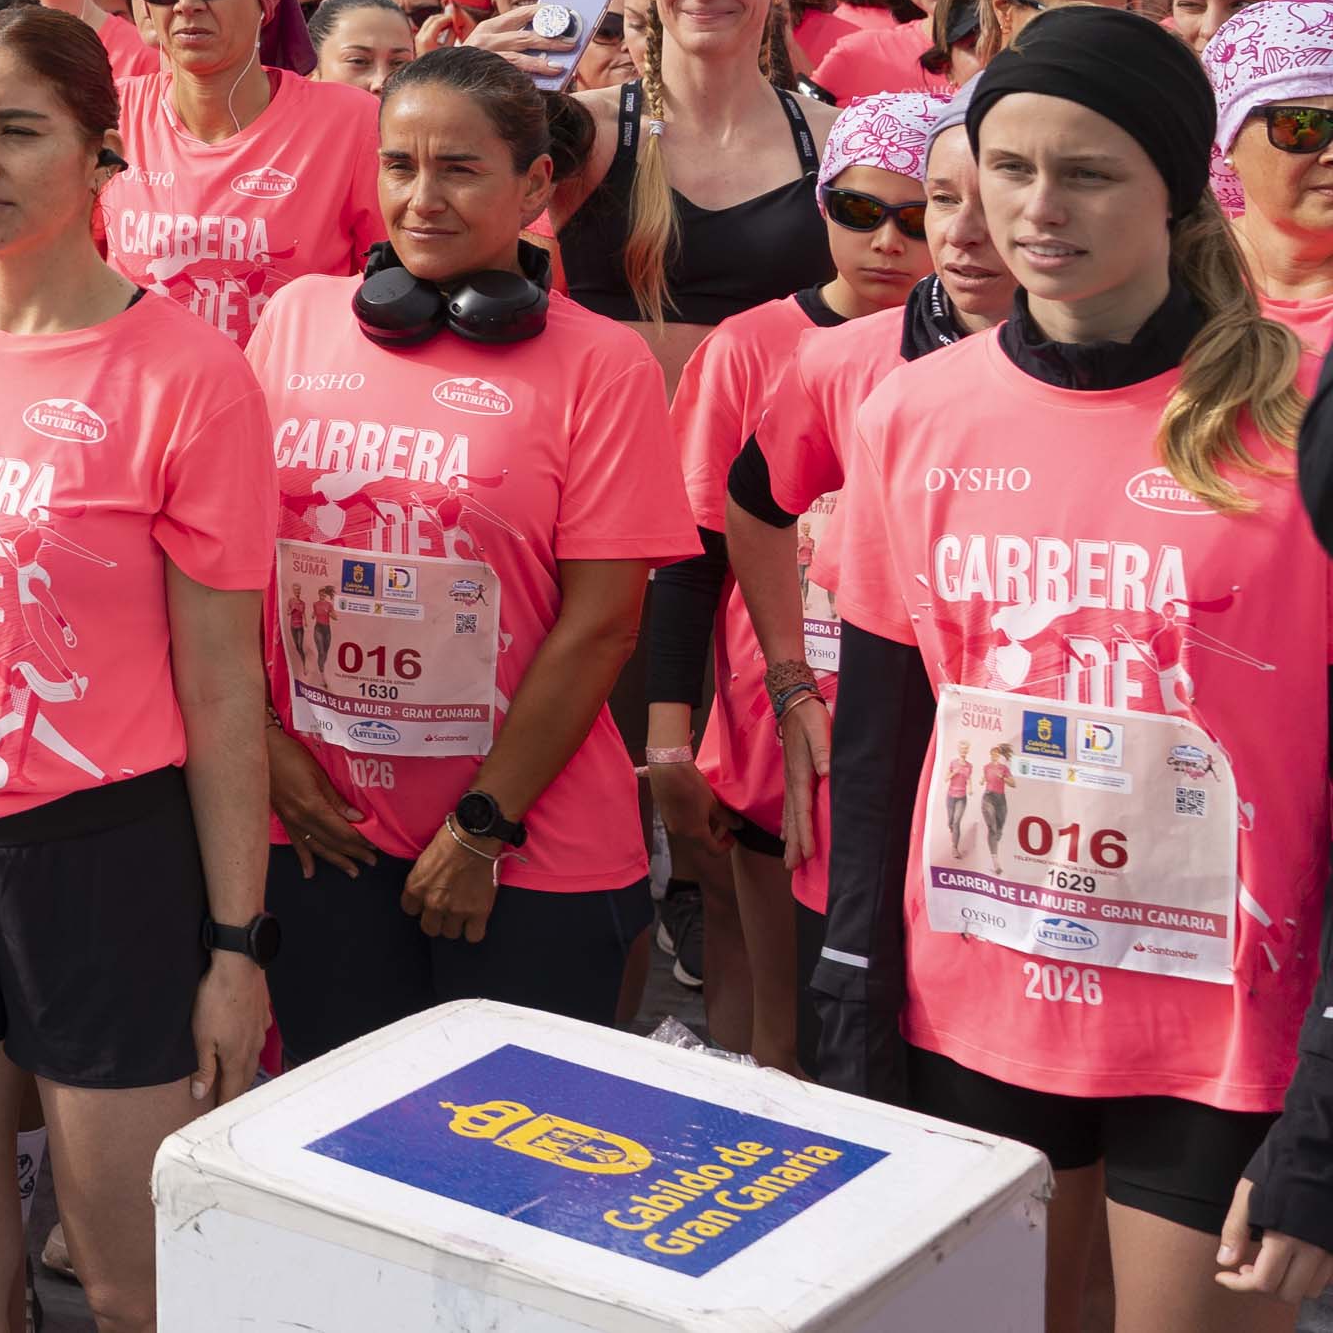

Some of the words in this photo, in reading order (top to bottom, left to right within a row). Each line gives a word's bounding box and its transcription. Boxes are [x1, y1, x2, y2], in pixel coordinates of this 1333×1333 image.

[120, 209, 270, 263] CARRERA
[286, 372, 365, 392] OYSHO
[438, 386, 506, 412] ASTURIANA
[33, 410, 100, 439] ASTURIANA
[275, 418, 469, 489] CARRERA
[924, 466, 1032, 494] OYSHO
[293, 560, 329, 577] SUMA
[933, 533, 1190, 619] CARRERA
[337, 642, 422, 680] 016
[1063, 633, 1146, 714] DE
[338, 699, 351, 712] LA
[354, 702, 391, 717] MUJER
[401, 707, 432, 719] GRAN
[435, 709, 482, 719] CANARIA
[358, 683, 399, 700] 1630
[353, 727, 397, 742] ASTURIANA
[433, 734, 470, 743] Santander
[961, 712, 1003, 732] SUMA
[1018, 816, 1129, 869] 016
[1047, 869, 1096, 893] 1629
[938, 871, 997, 896] CARRERA
[999, 886, 1016, 900] DE
[1020, 890, 1038, 906] LA
[1041, 893, 1087, 914] MUJER
[1100, 904, 1143, 921] GRAN
[1147, 907, 1216, 932] CANARIA
[961, 907, 1007, 929] OYSHO
[1146, 945, 1199, 960] Santander
[1023, 961, 1103, 1006] 2026
[603, 1164, 734, 1231] Cabildo
[714, 1141, 774, 1166] de
[643, 1209, 742, 1256] Gran
[714, 1145, 844, 1211] Canaria
